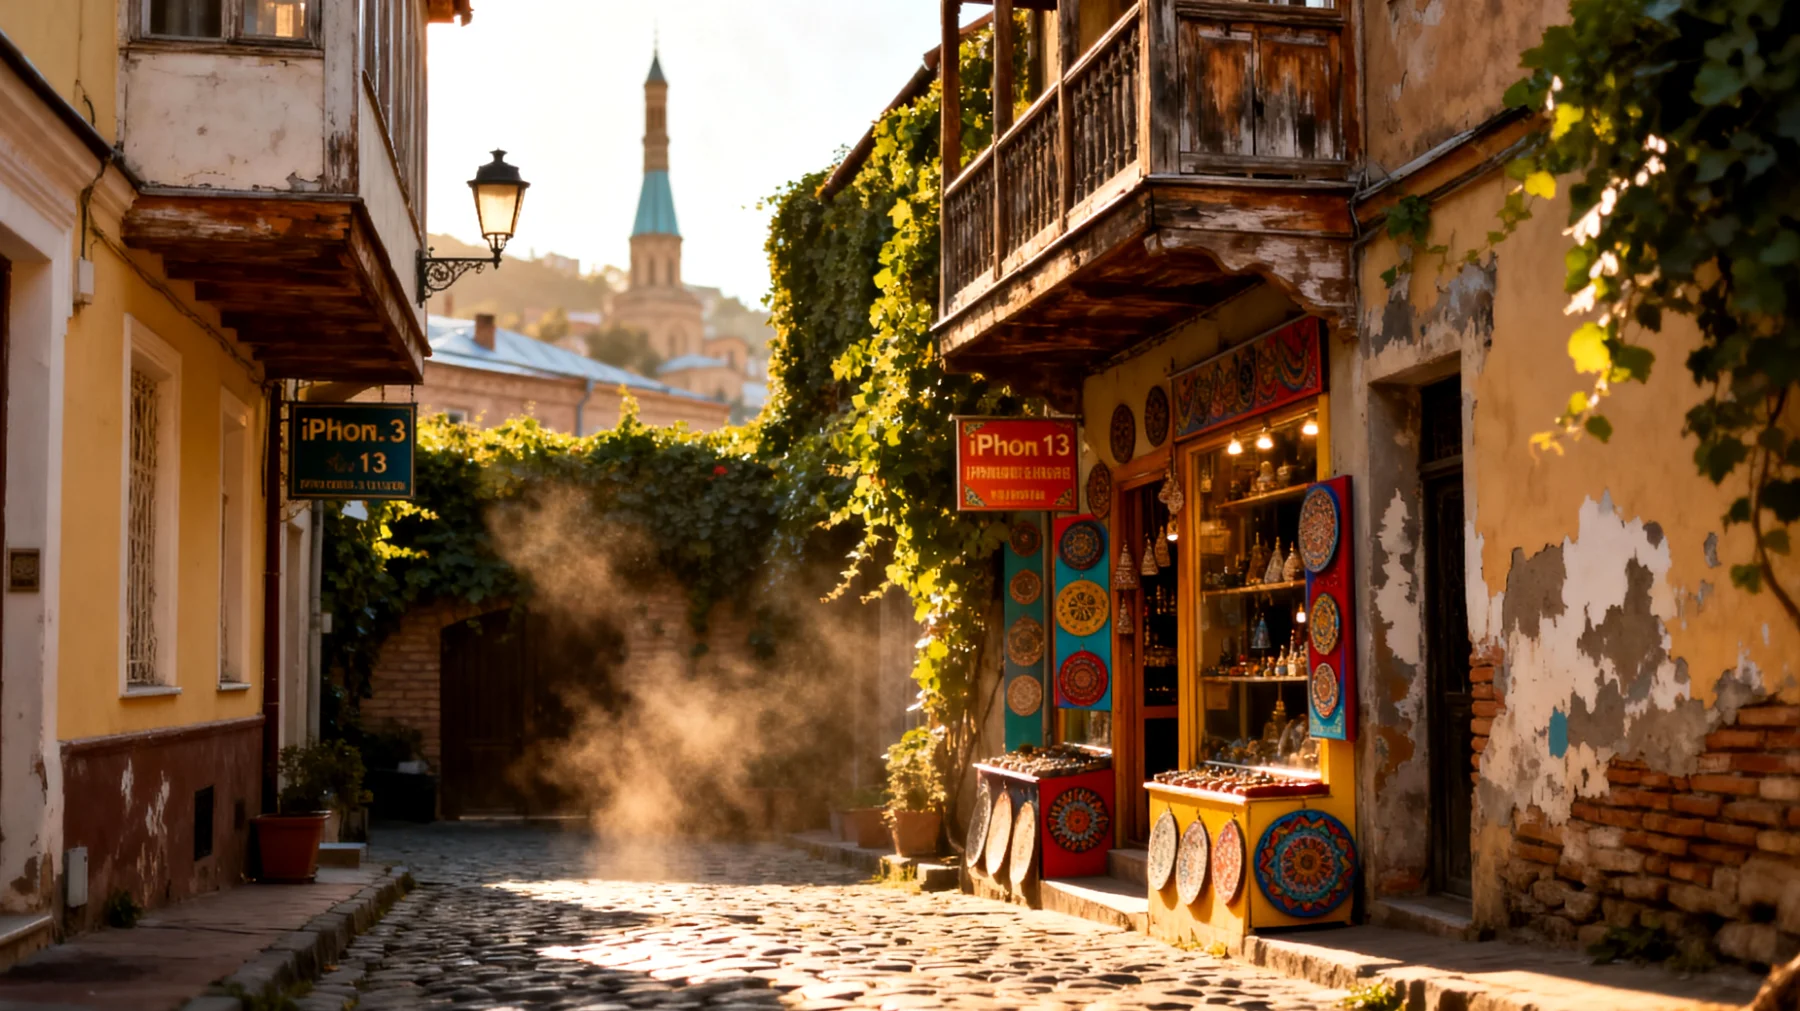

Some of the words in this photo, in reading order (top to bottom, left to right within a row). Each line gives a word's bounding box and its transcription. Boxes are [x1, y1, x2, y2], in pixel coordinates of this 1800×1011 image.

[389, 418, 407, 443] 3
[969, 433, 1039, 457] iPhon
[1042, 433, 1071, 457] 13
[359, 451, 388, 474] 13
